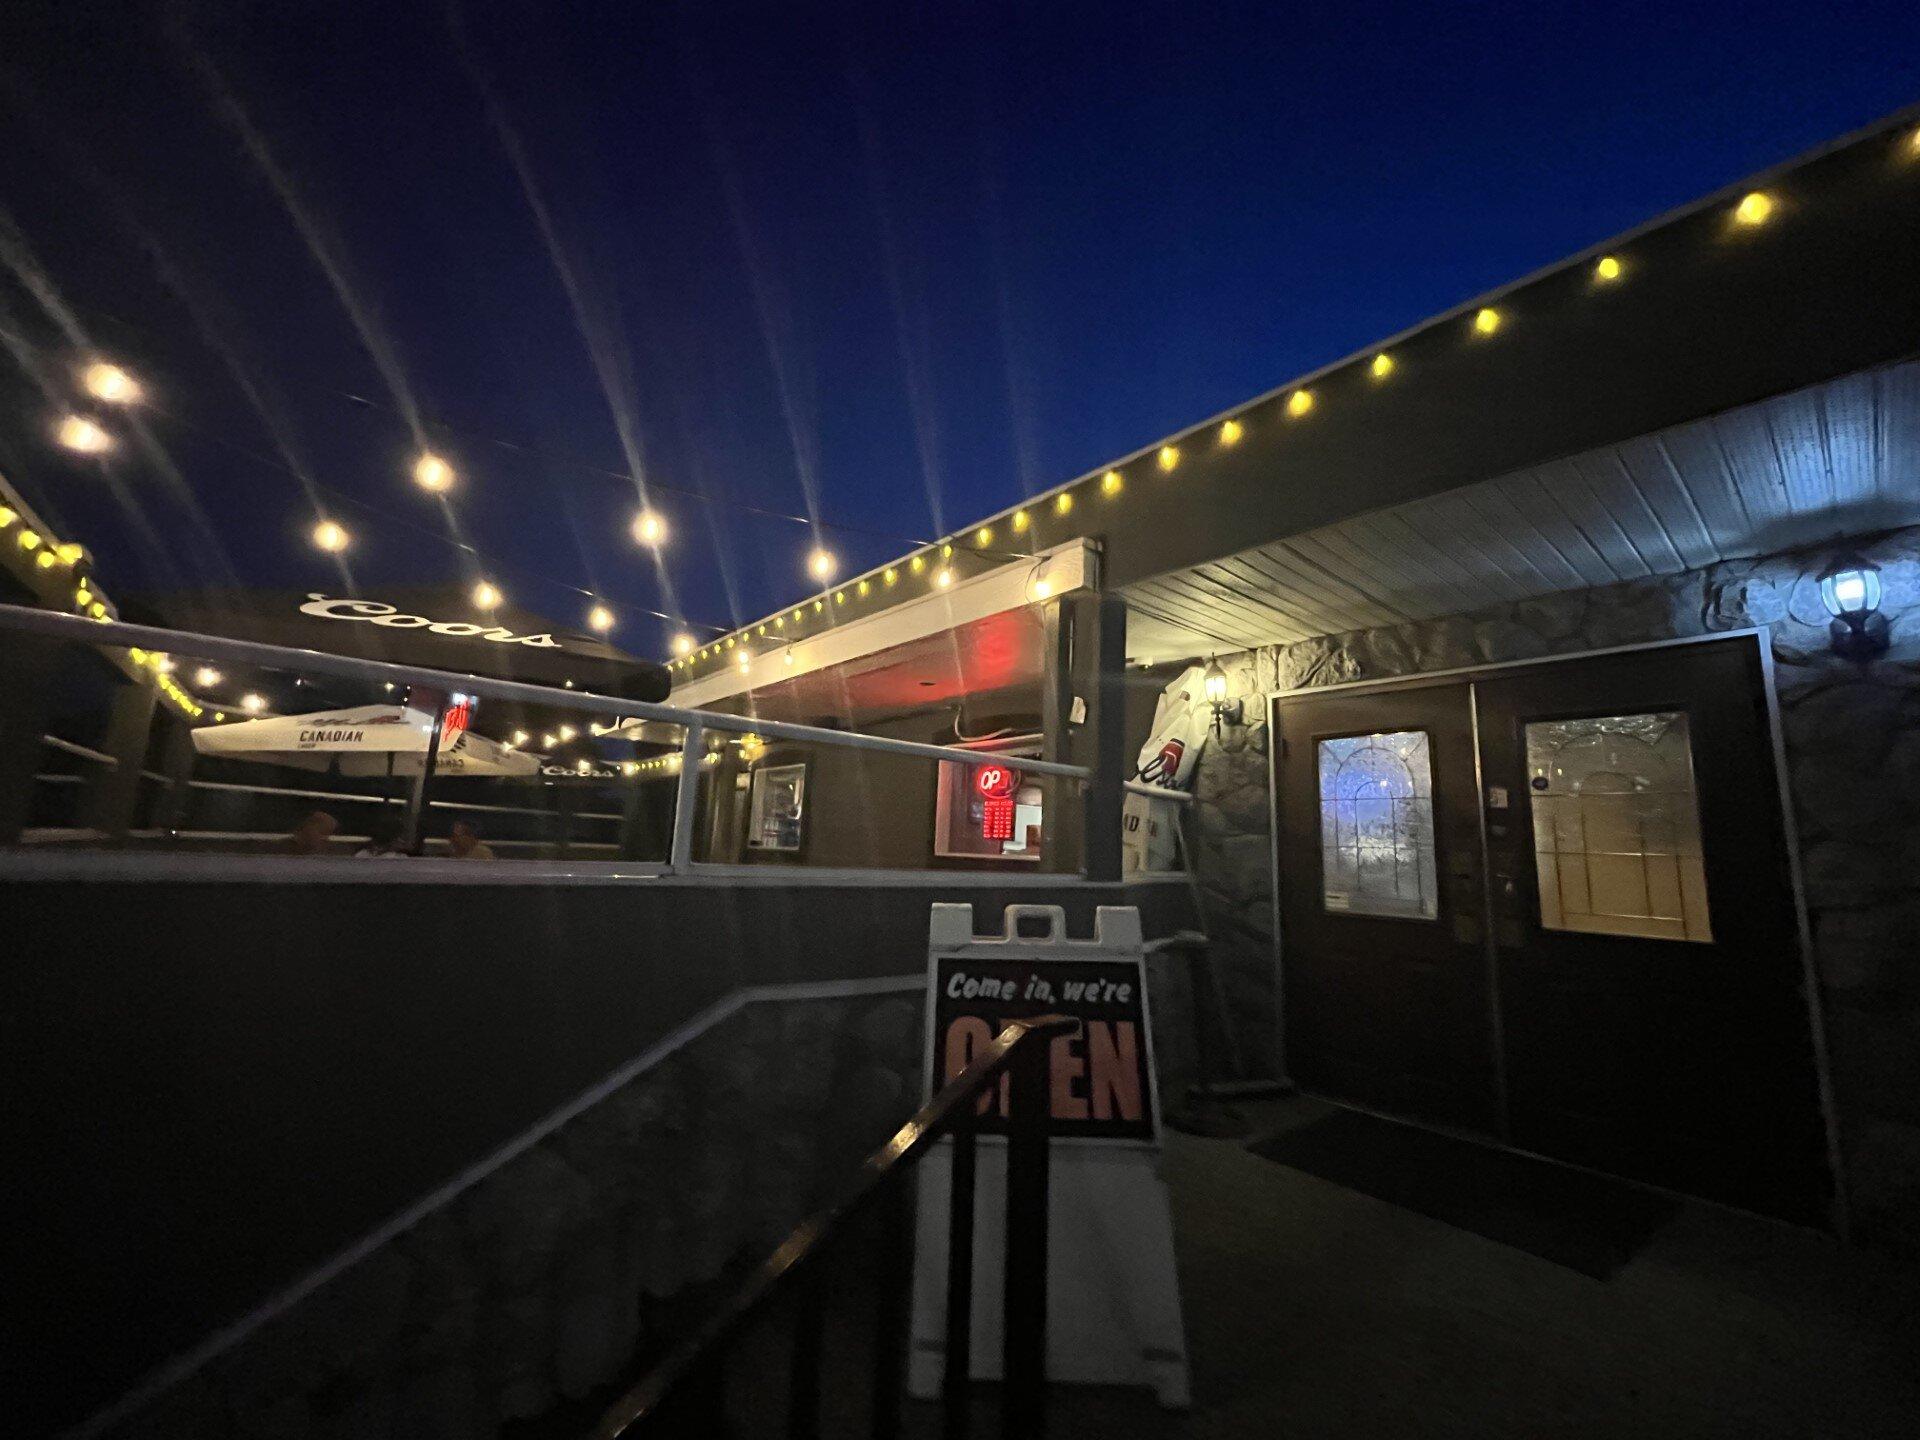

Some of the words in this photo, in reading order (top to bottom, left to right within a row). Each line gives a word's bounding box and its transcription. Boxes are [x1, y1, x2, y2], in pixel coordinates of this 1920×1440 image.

[299, 592, 562, 647] Coors
[300, 730, 364, 742] CANADIAN
[946, 972, 1018, 1002] Come
[1063, 977, 1133, 1004] we're
[945, 1014, 1143, 1121] OEN
